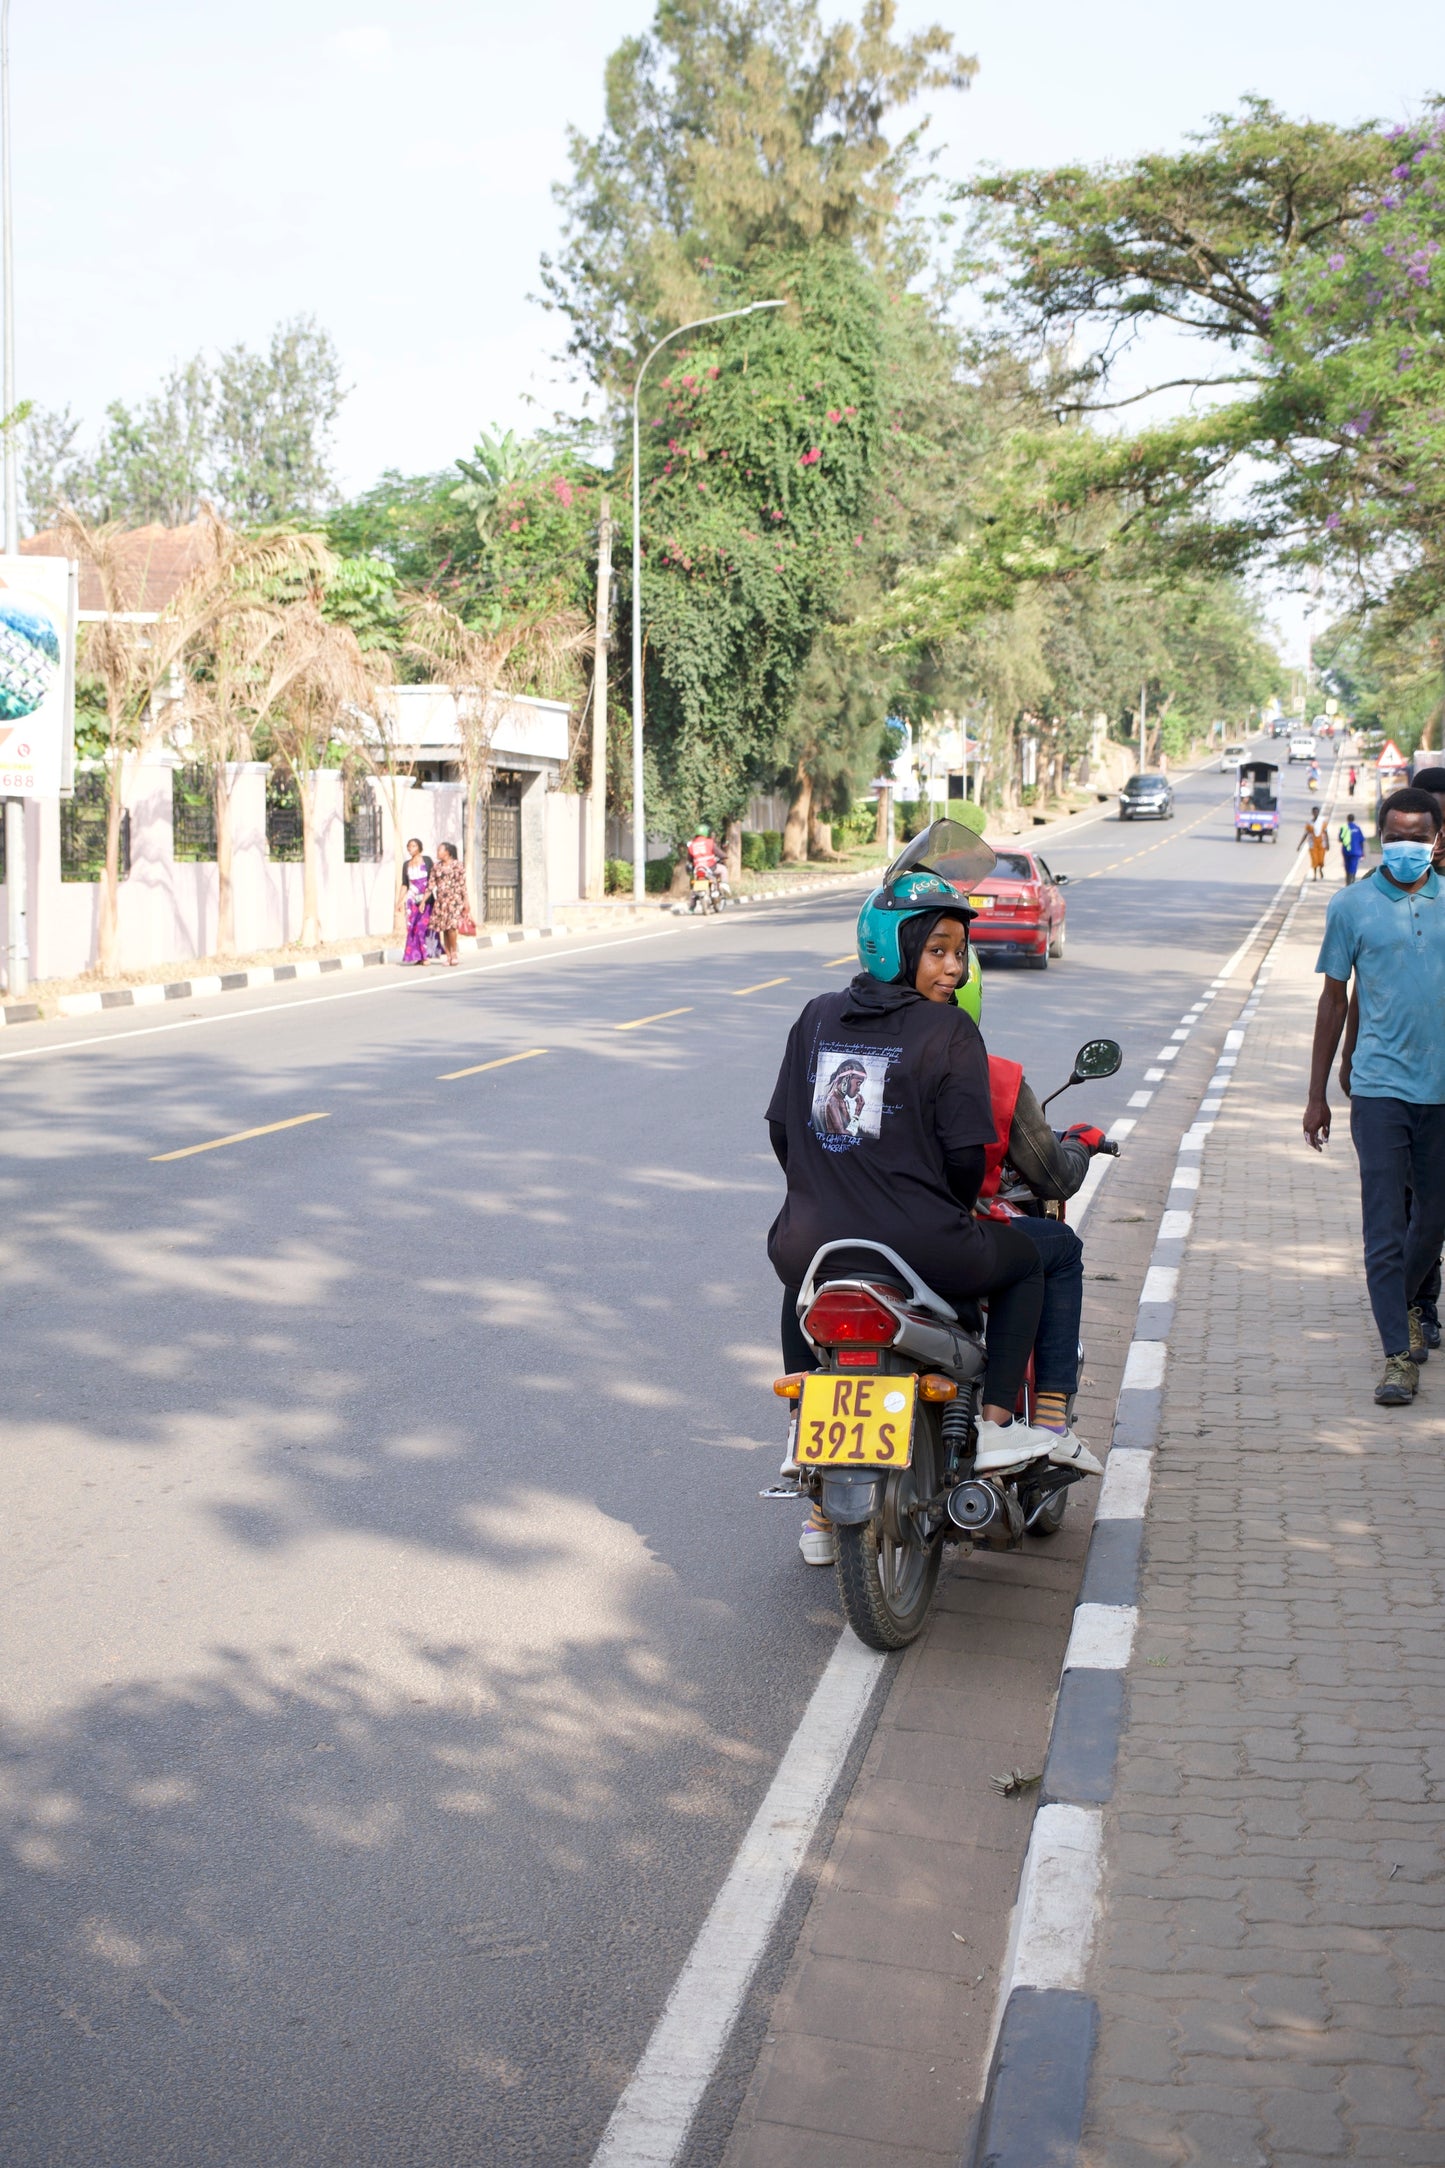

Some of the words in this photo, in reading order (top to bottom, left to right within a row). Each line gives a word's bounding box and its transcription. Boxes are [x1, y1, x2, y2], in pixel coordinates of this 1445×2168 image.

[907, 879, 939, 895] YEGO
[832, 1380, 874, 1417] RE
[805, 1421, 865, 1459] 391
[876, 1423, 896, 1461] S
